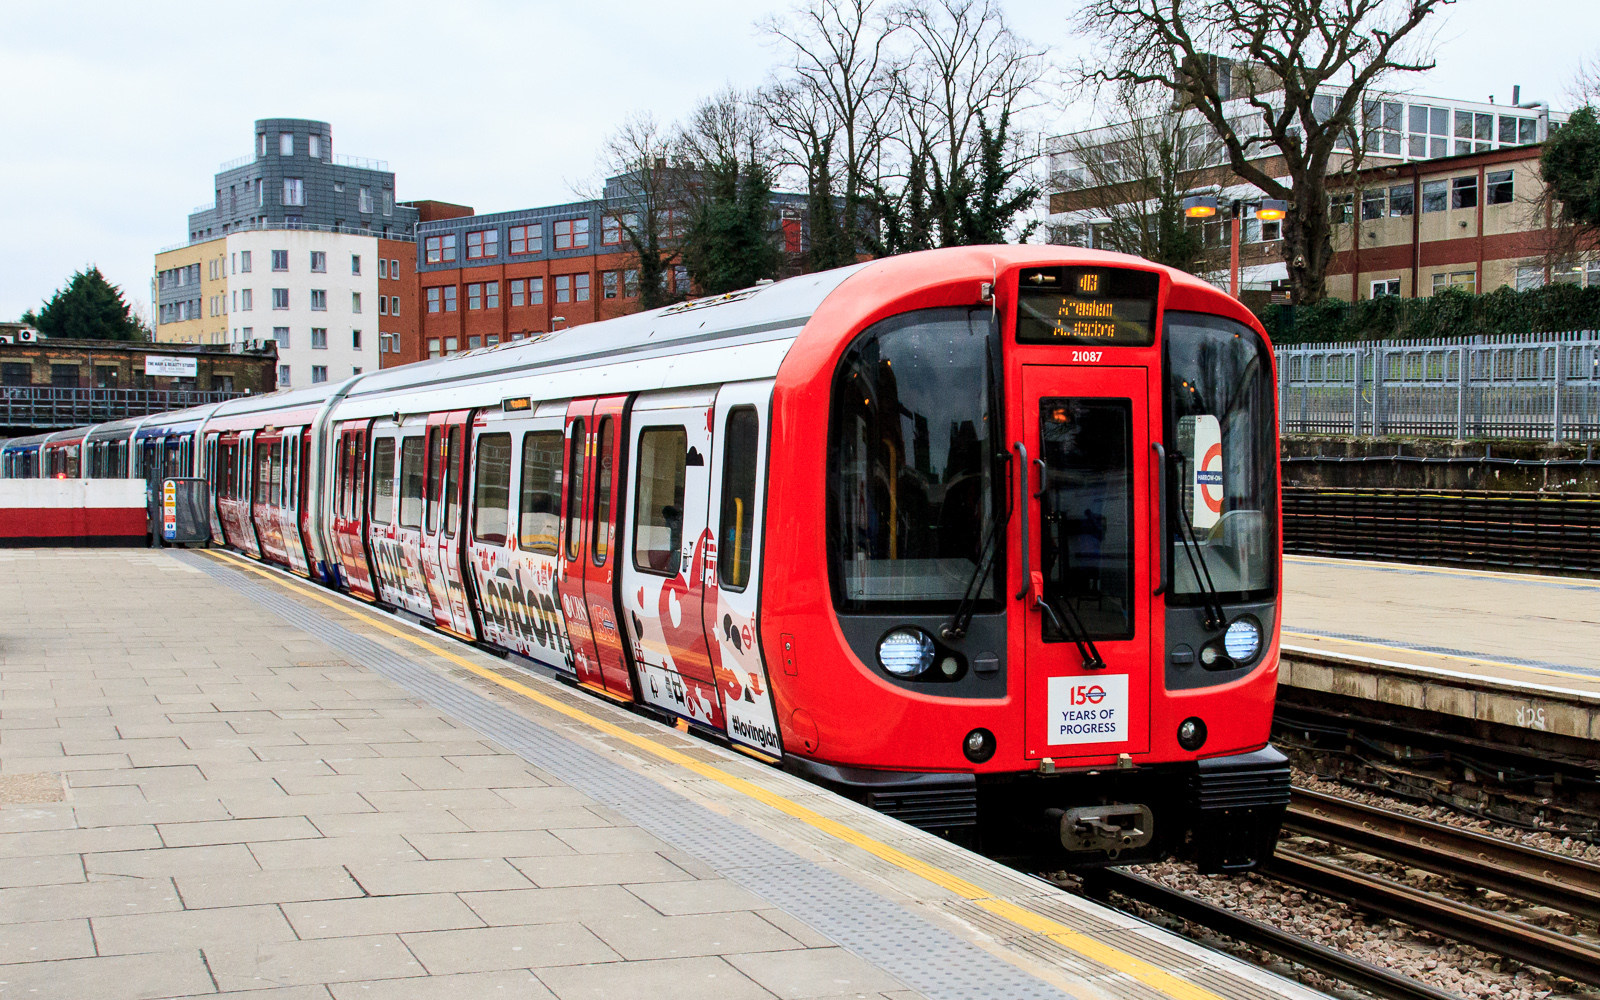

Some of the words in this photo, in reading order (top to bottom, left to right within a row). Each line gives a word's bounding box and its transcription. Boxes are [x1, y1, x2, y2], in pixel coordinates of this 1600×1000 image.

[1072, 351, 1102, 362] 21087
[569, 595, 587, 622] CBS
[1070, 685, 1105, 705] 150
[1062, 709, 1096, 721] YEARS
[1099, 708, 1115, 720] OF
[731, 714, 780, 750] #lovingldn
[1060, 722, 1116, 735] PROGRESS
